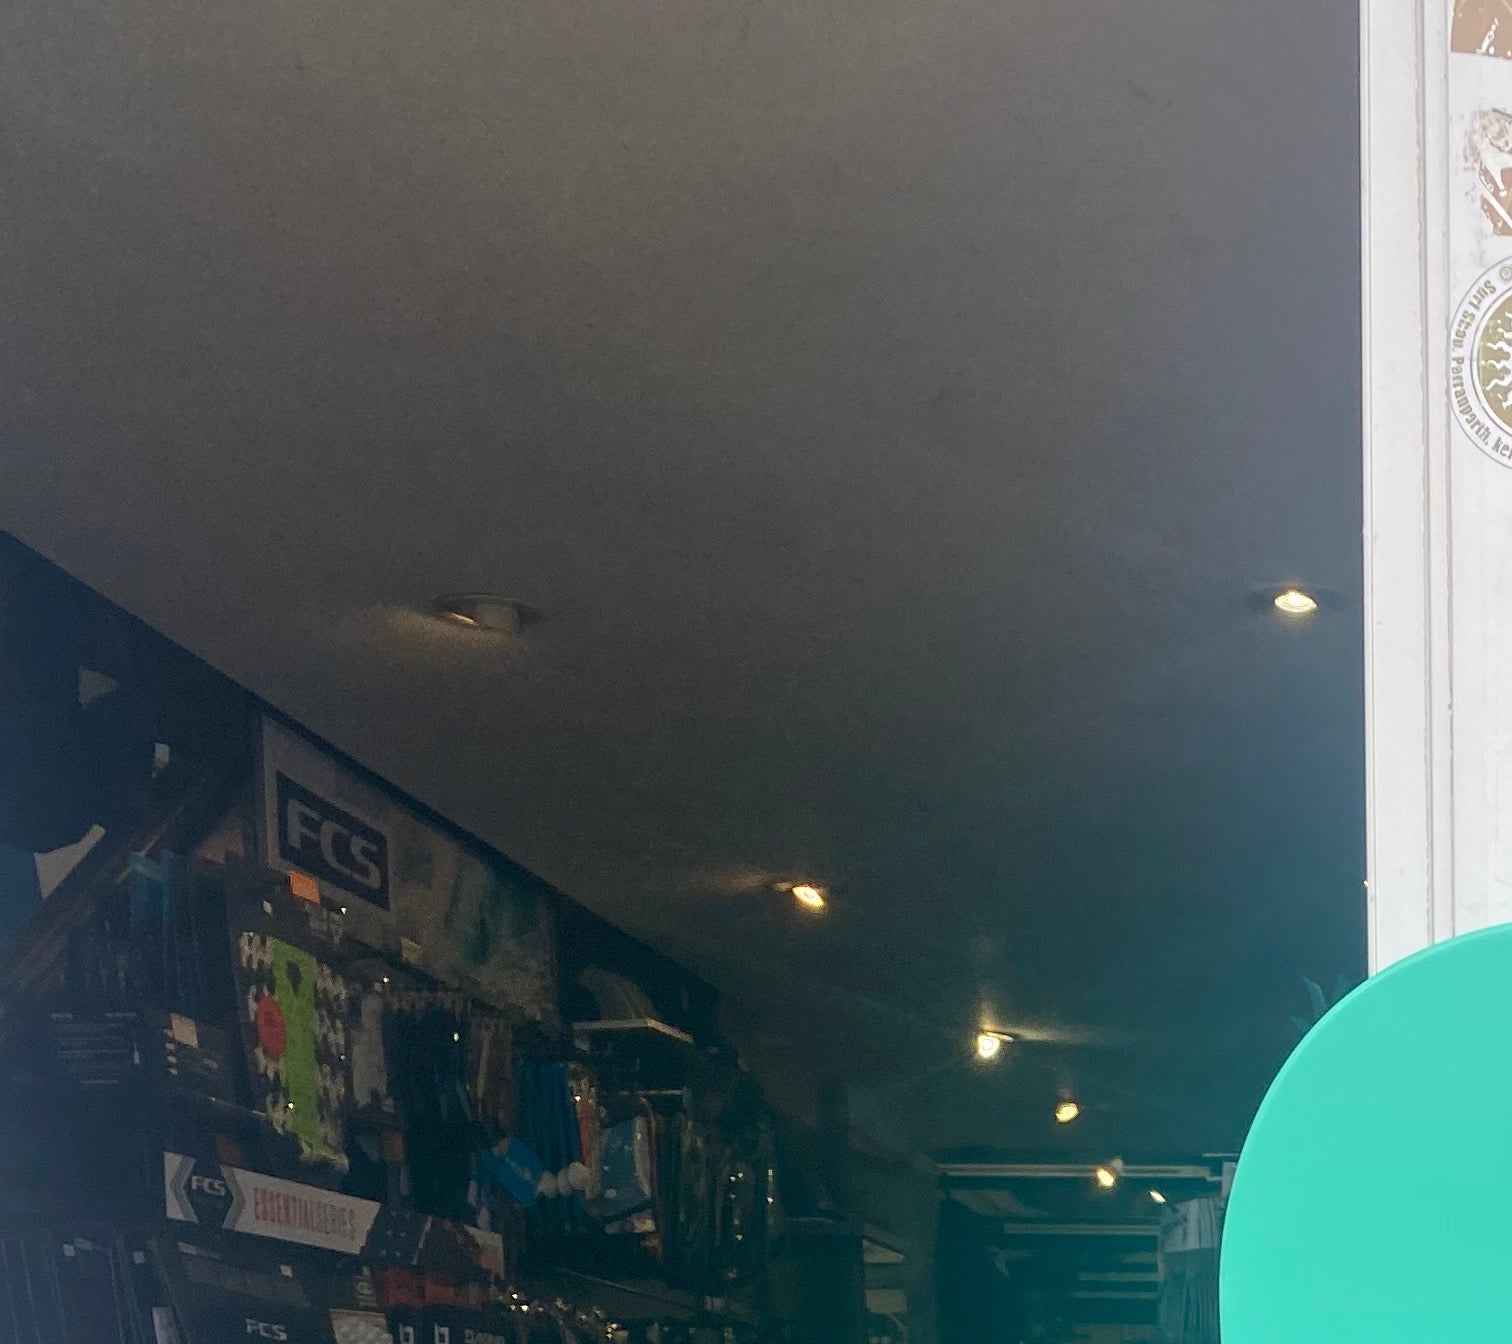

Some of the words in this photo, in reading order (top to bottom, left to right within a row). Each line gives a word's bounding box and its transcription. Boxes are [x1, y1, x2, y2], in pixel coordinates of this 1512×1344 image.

[288, 799, 381, 889] FCS
[191, 1176, 226, 1196] FCS
[246, 1318, 288, 1341] FCS
